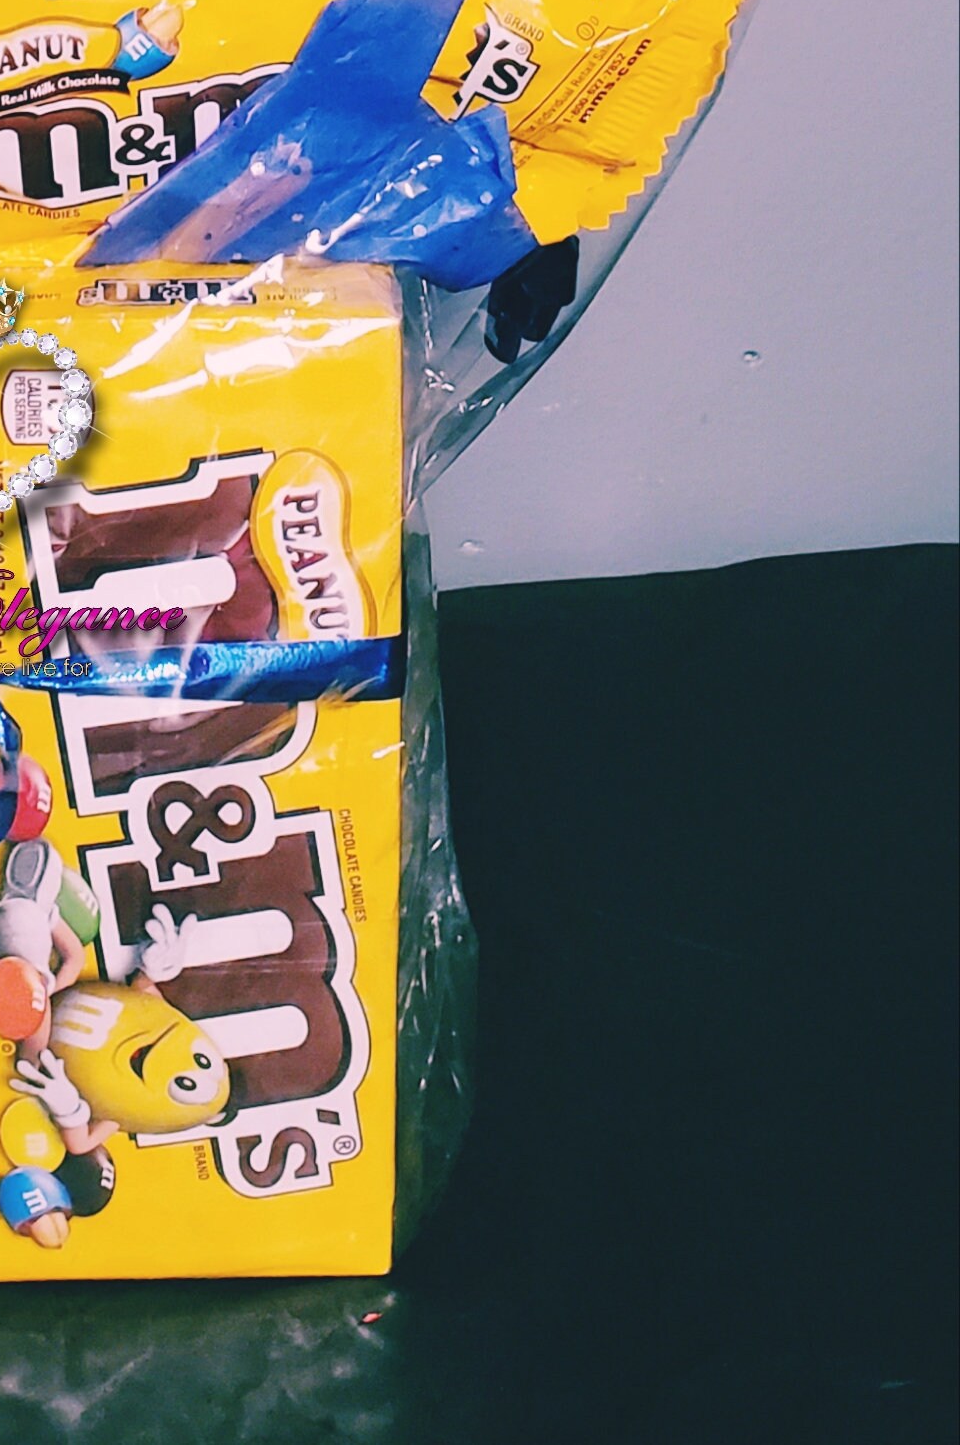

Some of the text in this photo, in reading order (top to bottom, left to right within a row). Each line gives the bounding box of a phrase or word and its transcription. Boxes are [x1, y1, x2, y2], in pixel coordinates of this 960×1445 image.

[125, 32, 153, 62] m
[502, 13, 546, 43] BRAND
[0, 89, 29, 106] Real
[30, 80, 57, 100] Milk
[57, 72, 121, 93] Chocolate
[576, 35, 653, 124] mms.com
[27, 205, 82, 220] CANDIES
[13, 376, 27, 440] PER SERVING
[27, 377, 43, 437] CALORIES
[280, 487, 352, 640] PEANU
[30, 459, 360, 1193] m&m's
[339, 808, 368, 924] CHOCOLATE CANDIES
[52, 993, 125, 1051] m
[100, 1158, 116, 1190] m
[192, 1144, 211, 1182] BRAND
[23, 1187, 49, 1216] m
